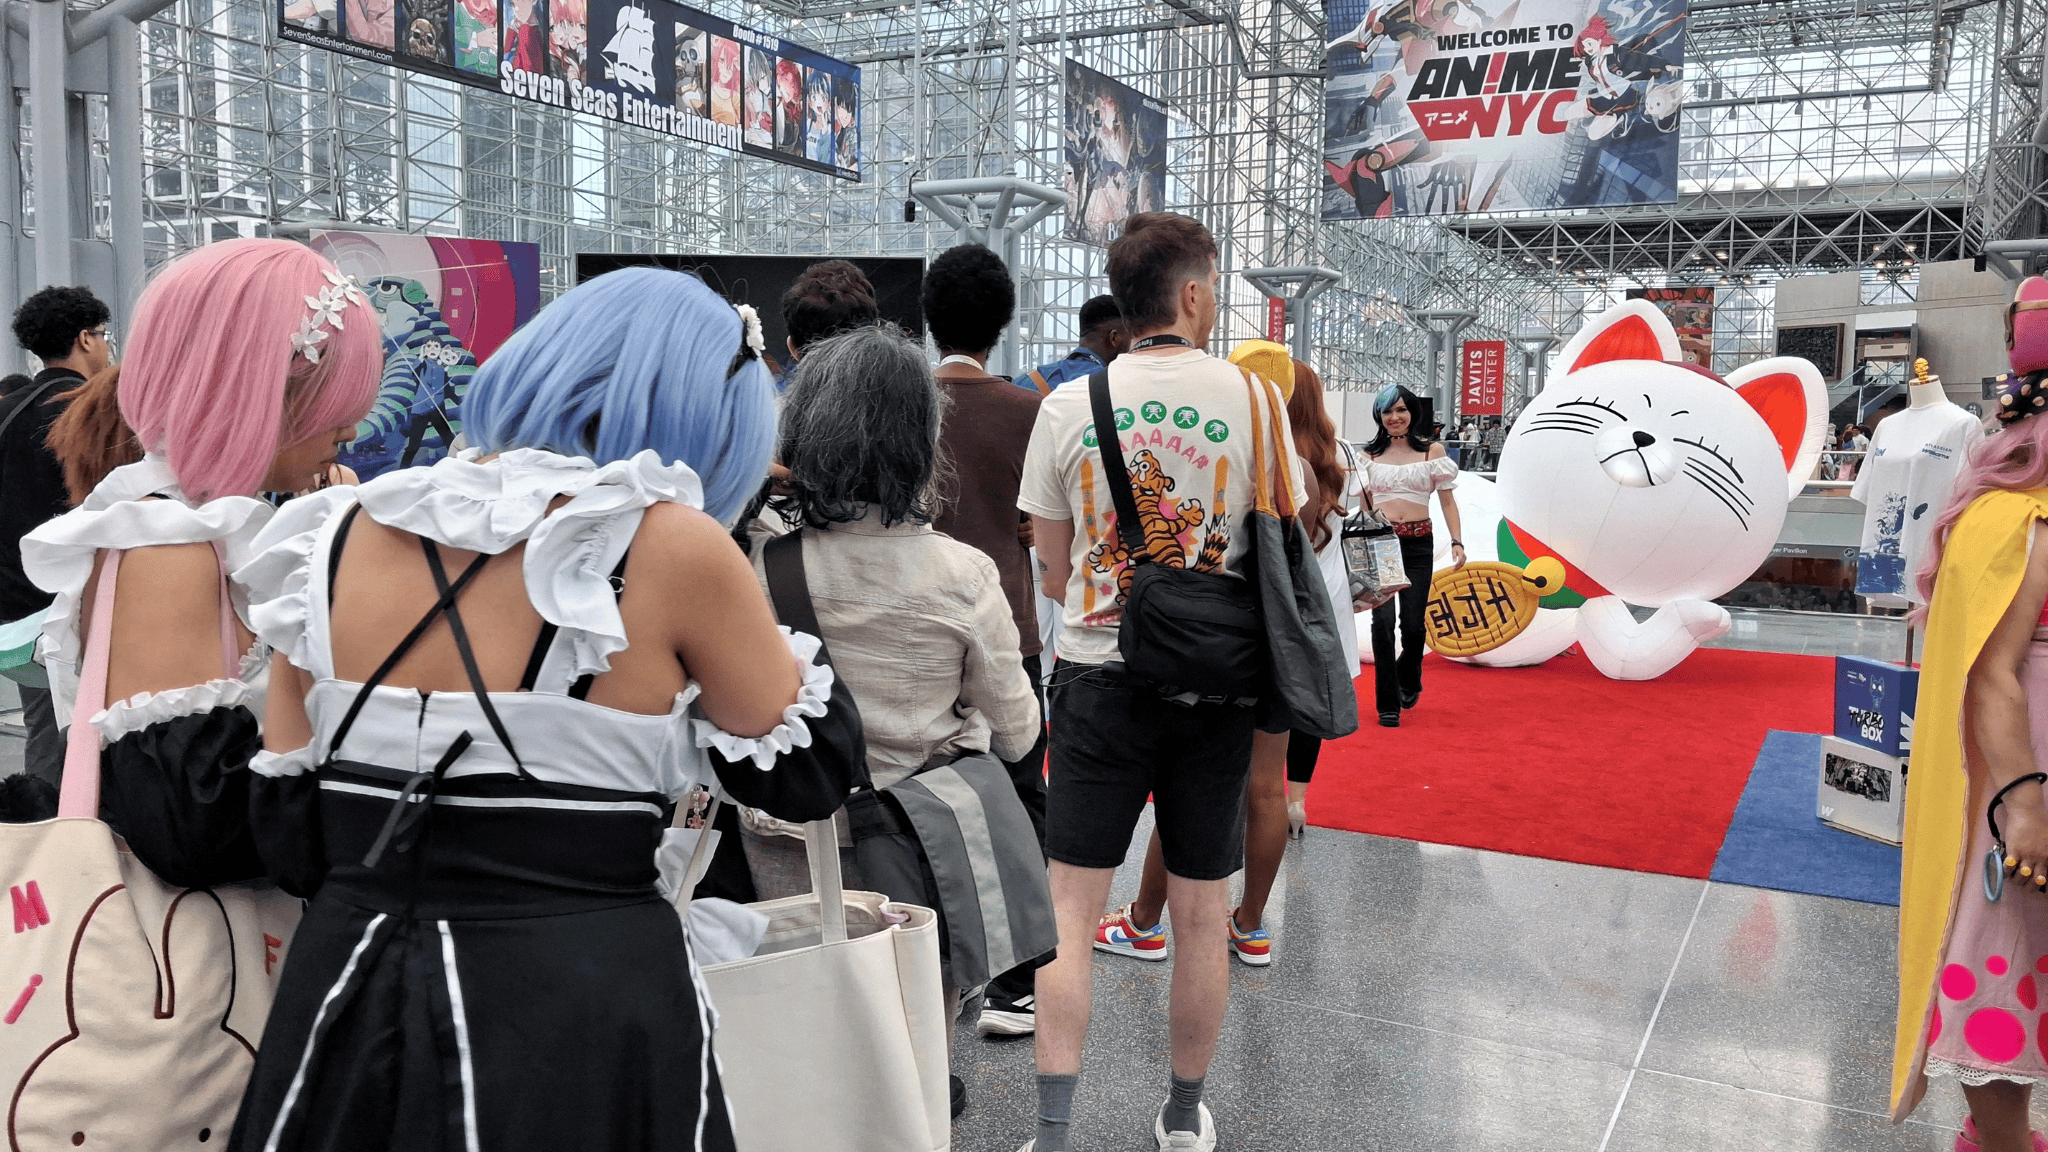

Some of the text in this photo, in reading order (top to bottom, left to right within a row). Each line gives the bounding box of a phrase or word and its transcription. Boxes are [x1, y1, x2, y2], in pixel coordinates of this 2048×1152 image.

[283, 26, 393, 62] SevenSeasEntertainment.com
[732, 24, 756, 44] Booth
[1437, 23, 1574, 52] WELCOME TO
[500, 60, 743, 152] Seven Seas Entertainment
[1424, 109, 1469, 128] アニメ
[1469, 89, 1578, 139] NYC
[1468, 350, 1483, 405] JAVITS
[1485, 349, 1498, 405] CENTER
[1861, 723, 1884, 743] BOX
